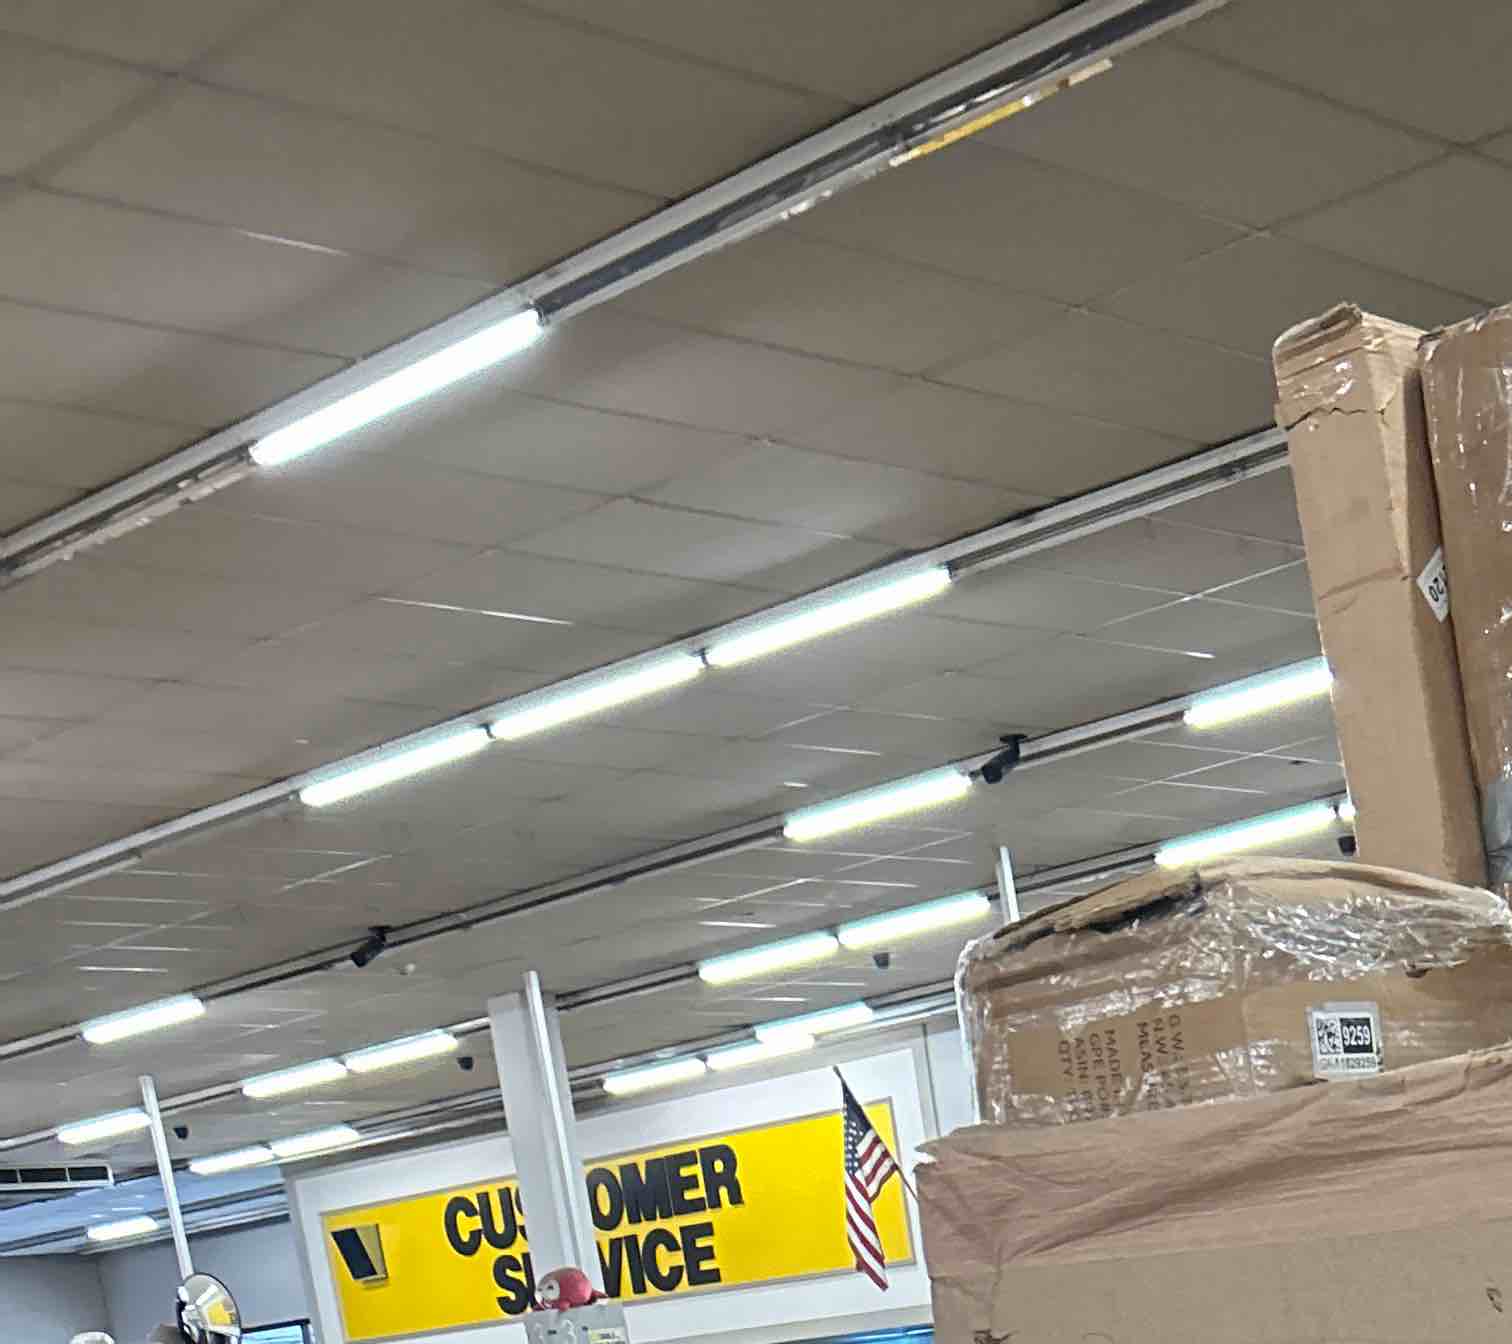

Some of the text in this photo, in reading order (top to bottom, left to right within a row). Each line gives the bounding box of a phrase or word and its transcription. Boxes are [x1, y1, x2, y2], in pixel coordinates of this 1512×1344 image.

[1341, 1023, 1372, 1049] 9259
[444, 1144, 744, 1256] CUOMER
[493, 1222, 721, 1315] SVICE
